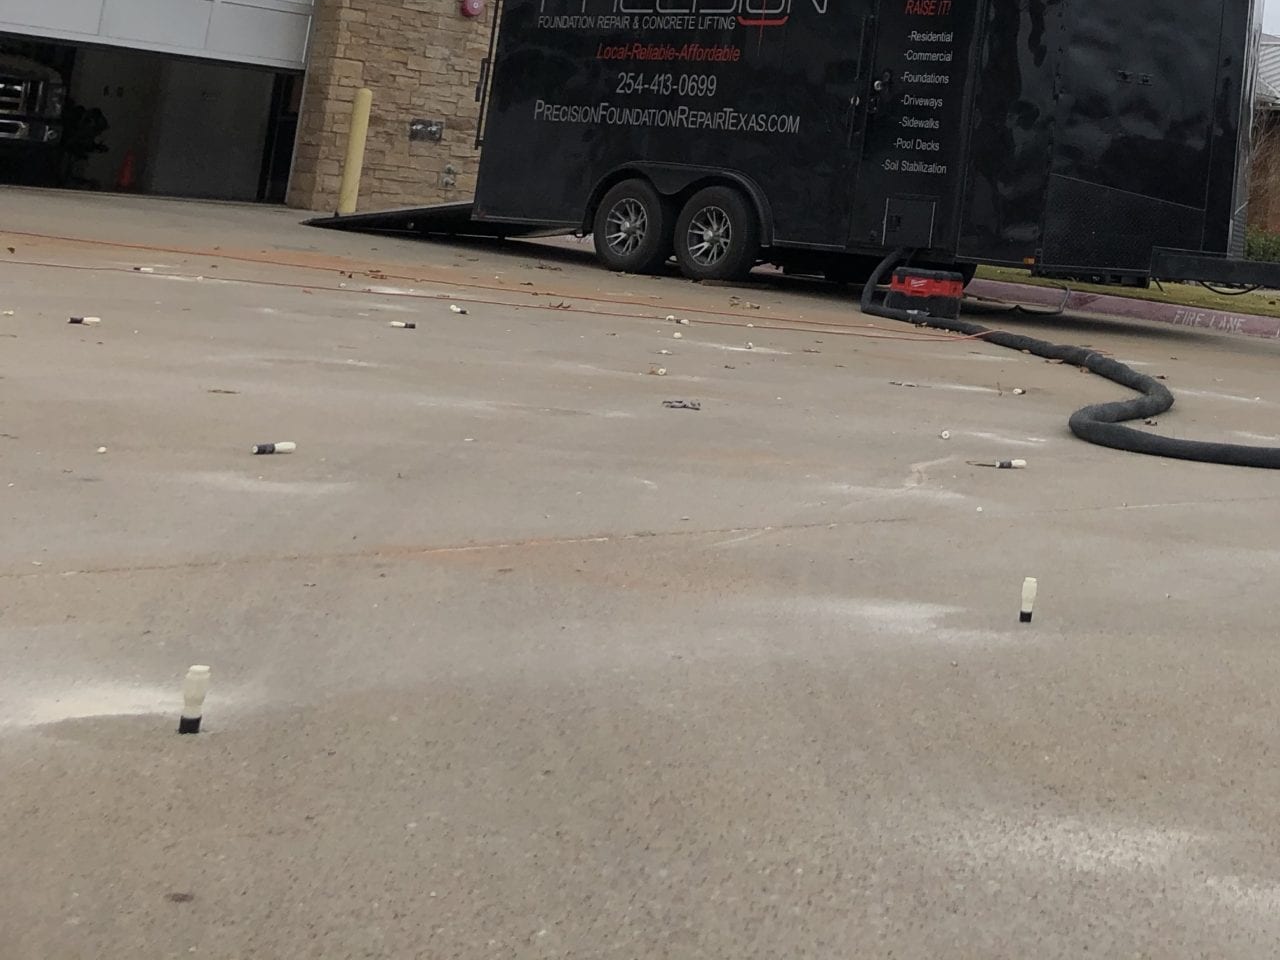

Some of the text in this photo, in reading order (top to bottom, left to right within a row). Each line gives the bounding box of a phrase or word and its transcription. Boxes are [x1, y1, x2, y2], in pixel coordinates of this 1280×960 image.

[905, 0, 937, 15] RAISE
[538, 15, 736, 30] FOUNDATION REPAIR & CONCRETE LIFTING
[596, 42, 741, 62] Local-Reliable-Affordable
[616, 72, 717, 97] 254-413-0699
[915, 138, 940, 151] Decks
[901, 160, 947, 175] Stabilization
[1172, 310, 1247, 335] FIRE LANE
